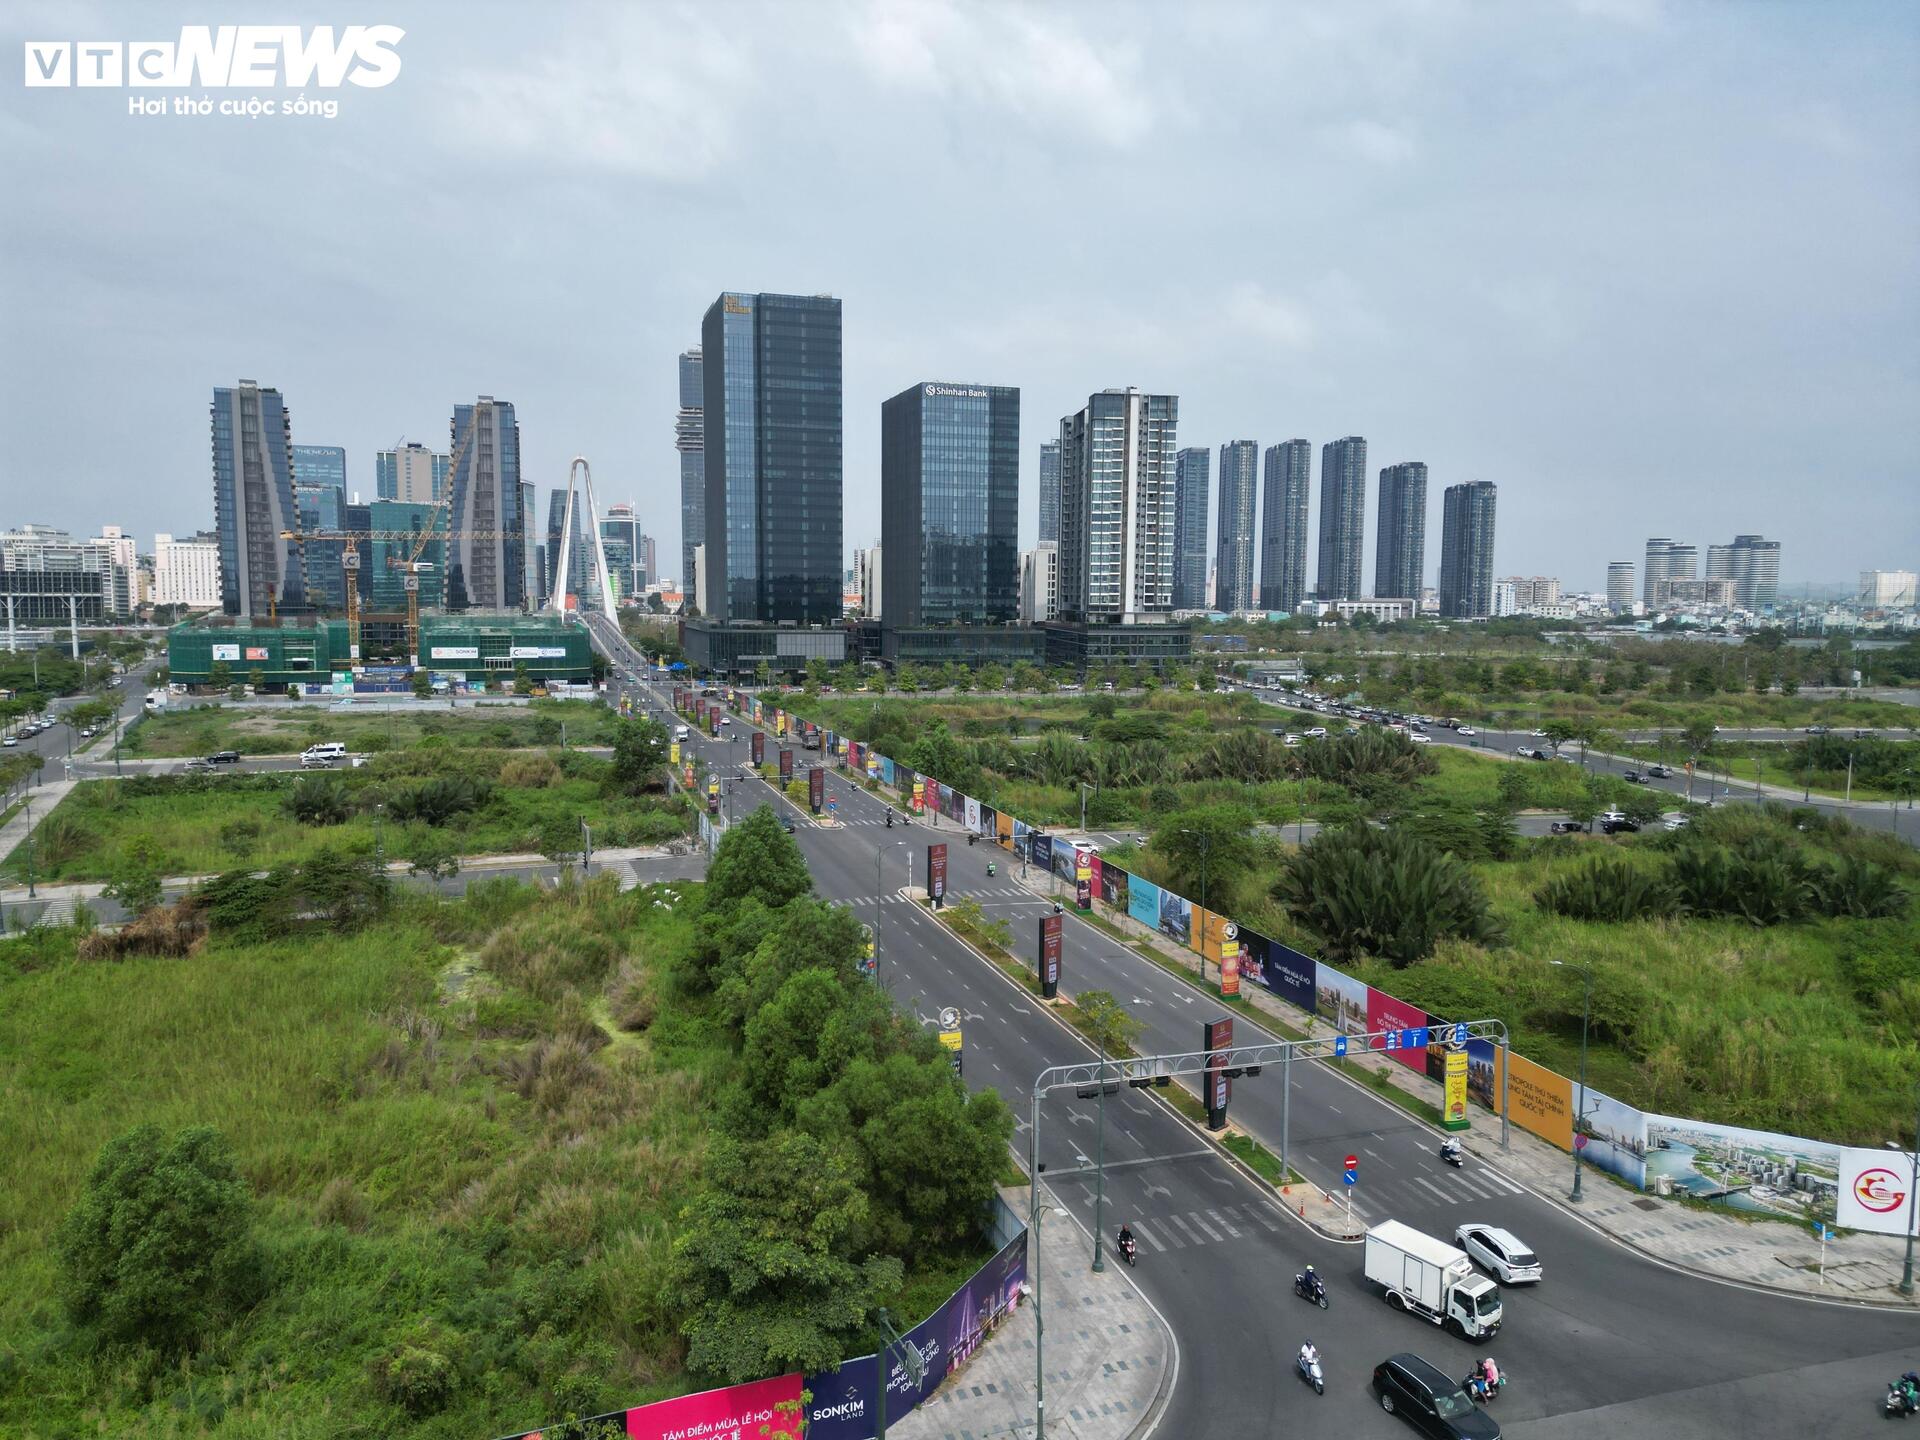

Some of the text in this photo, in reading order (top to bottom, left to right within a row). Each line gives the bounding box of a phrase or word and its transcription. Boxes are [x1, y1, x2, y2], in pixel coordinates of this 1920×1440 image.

[936, 387, 988, 398] Shinhan Bank
[1507, 1073, 1534, 1091] ETROPOLE
[813, 1399, 864, 1421] SONKIM
[841, 1410, 864, 1421] LAND
[662, 1409, 773, 1440] TÂM ĐIỂM MÙA LỄ HỘI
